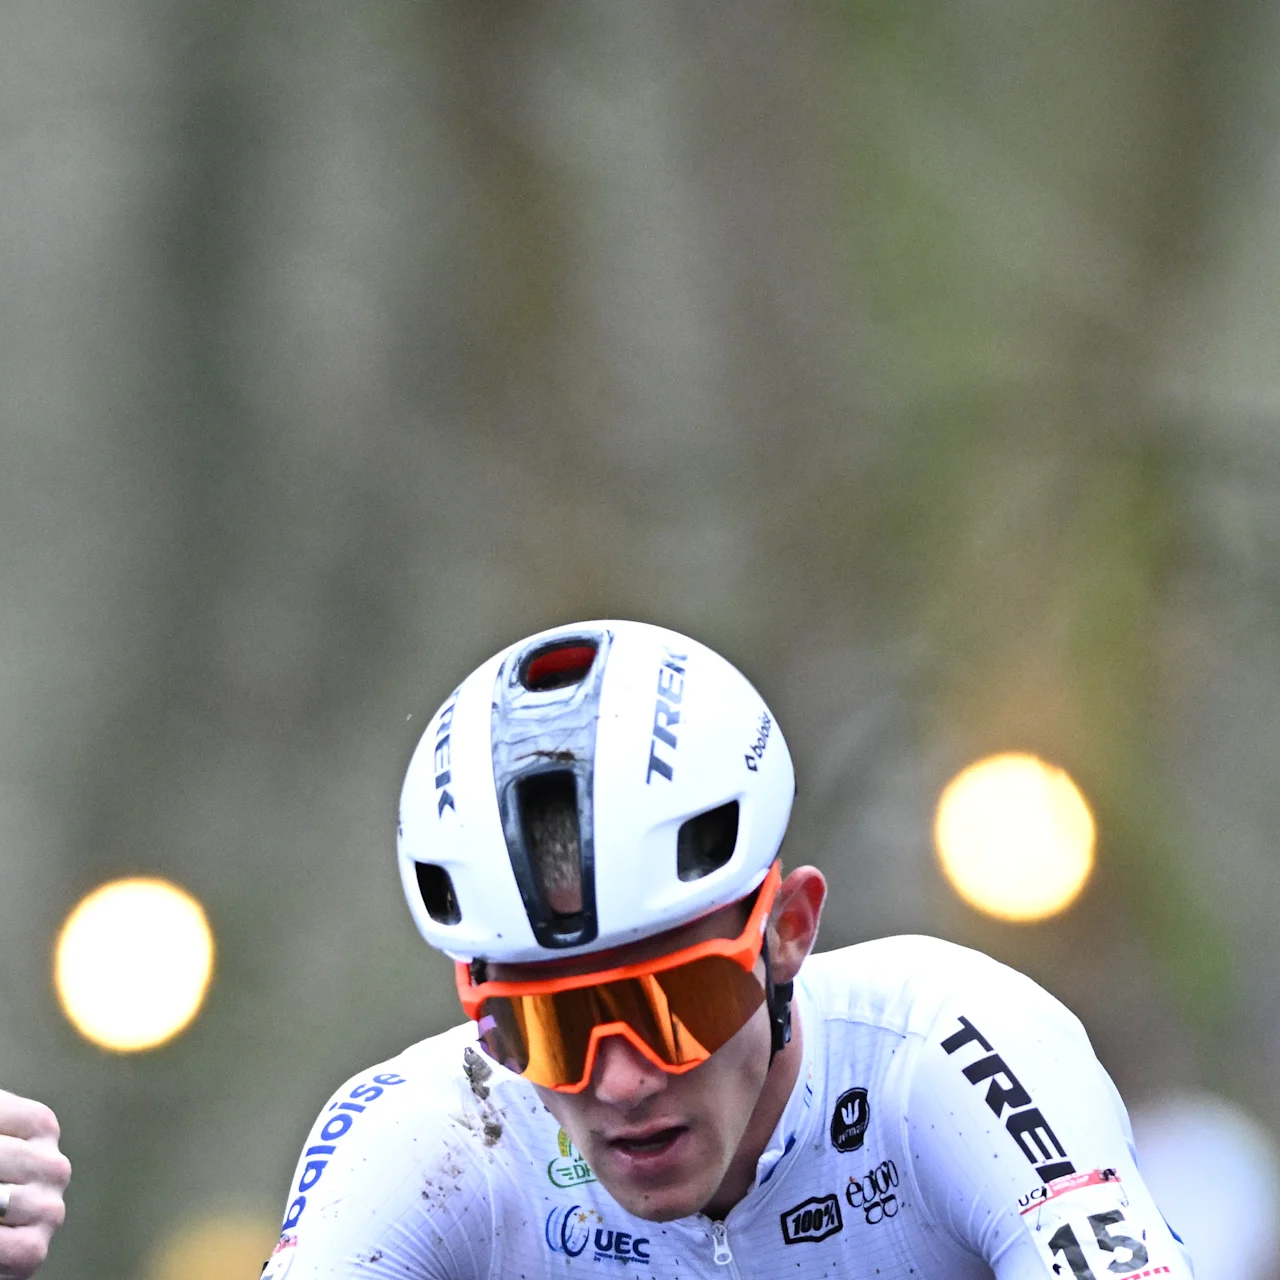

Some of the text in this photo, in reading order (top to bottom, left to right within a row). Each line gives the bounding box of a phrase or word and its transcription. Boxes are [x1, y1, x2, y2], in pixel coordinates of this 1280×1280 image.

[434, 689, 460, 821] REK
[646, 645, 688, 785] TREK
[282, 1073, 407, 1232] baloise
[594, 1228, 650, 1258] UEC
[792, 1201, 836, 1237] 100%
